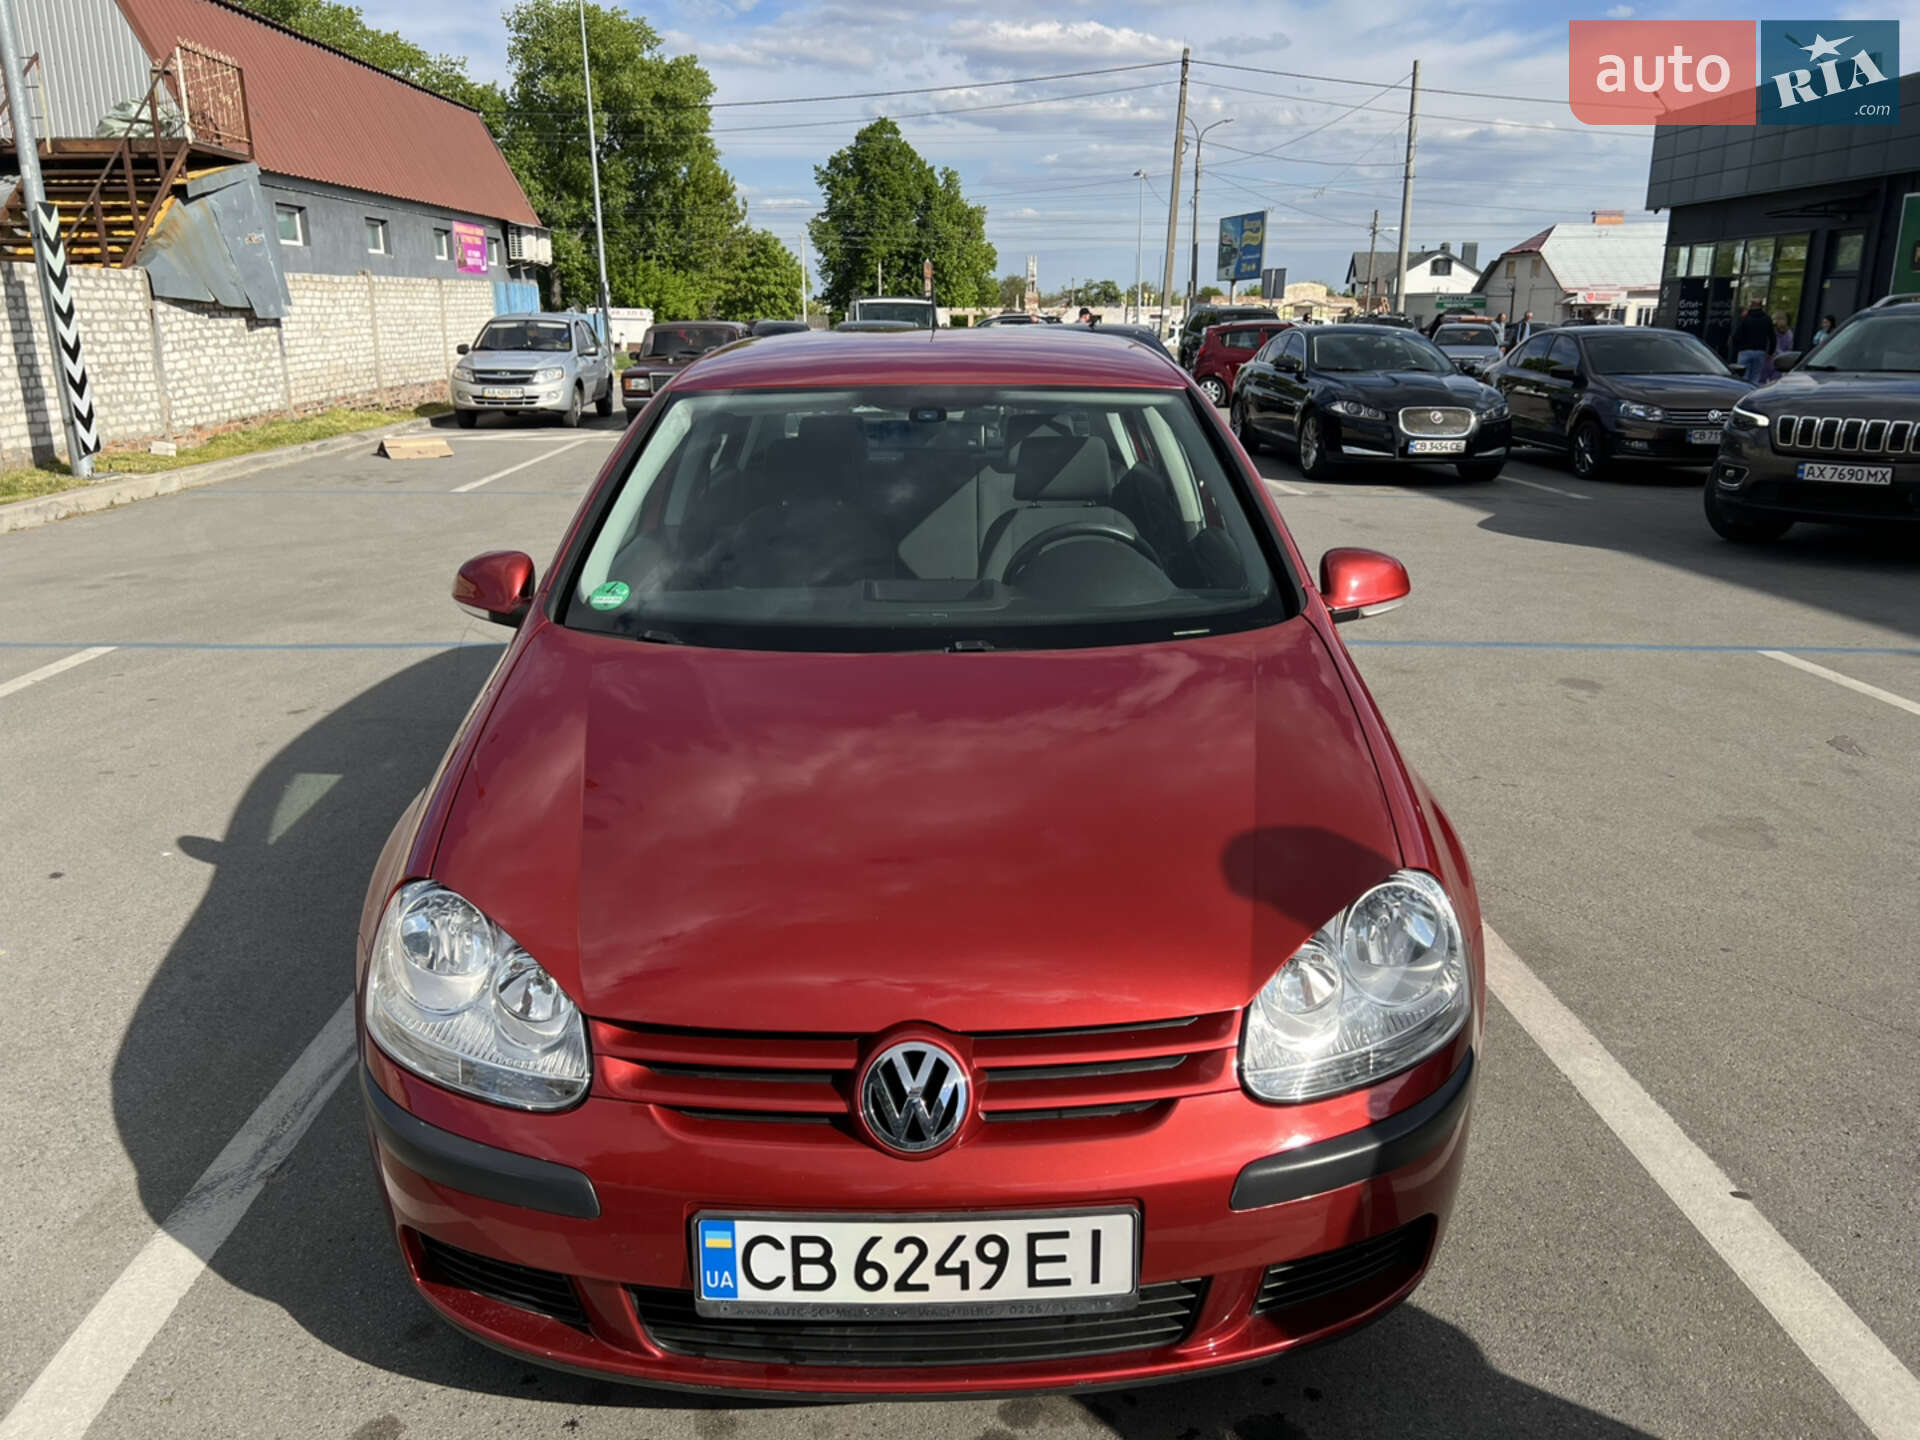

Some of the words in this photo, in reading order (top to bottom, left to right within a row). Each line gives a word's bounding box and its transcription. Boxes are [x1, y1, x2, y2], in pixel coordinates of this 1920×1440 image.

[1806, 466, 1827, 479] AX
[1830, 467, 1864, 481] 7690
[1866, 469, 1890, 483] MX
[741, 1234, 838, 1293] CB
[852, 1234, 1010, 1292] 6249
[1025, 1229, 1102, 1289] EI
[706, 1270, 734, 1289] UA
